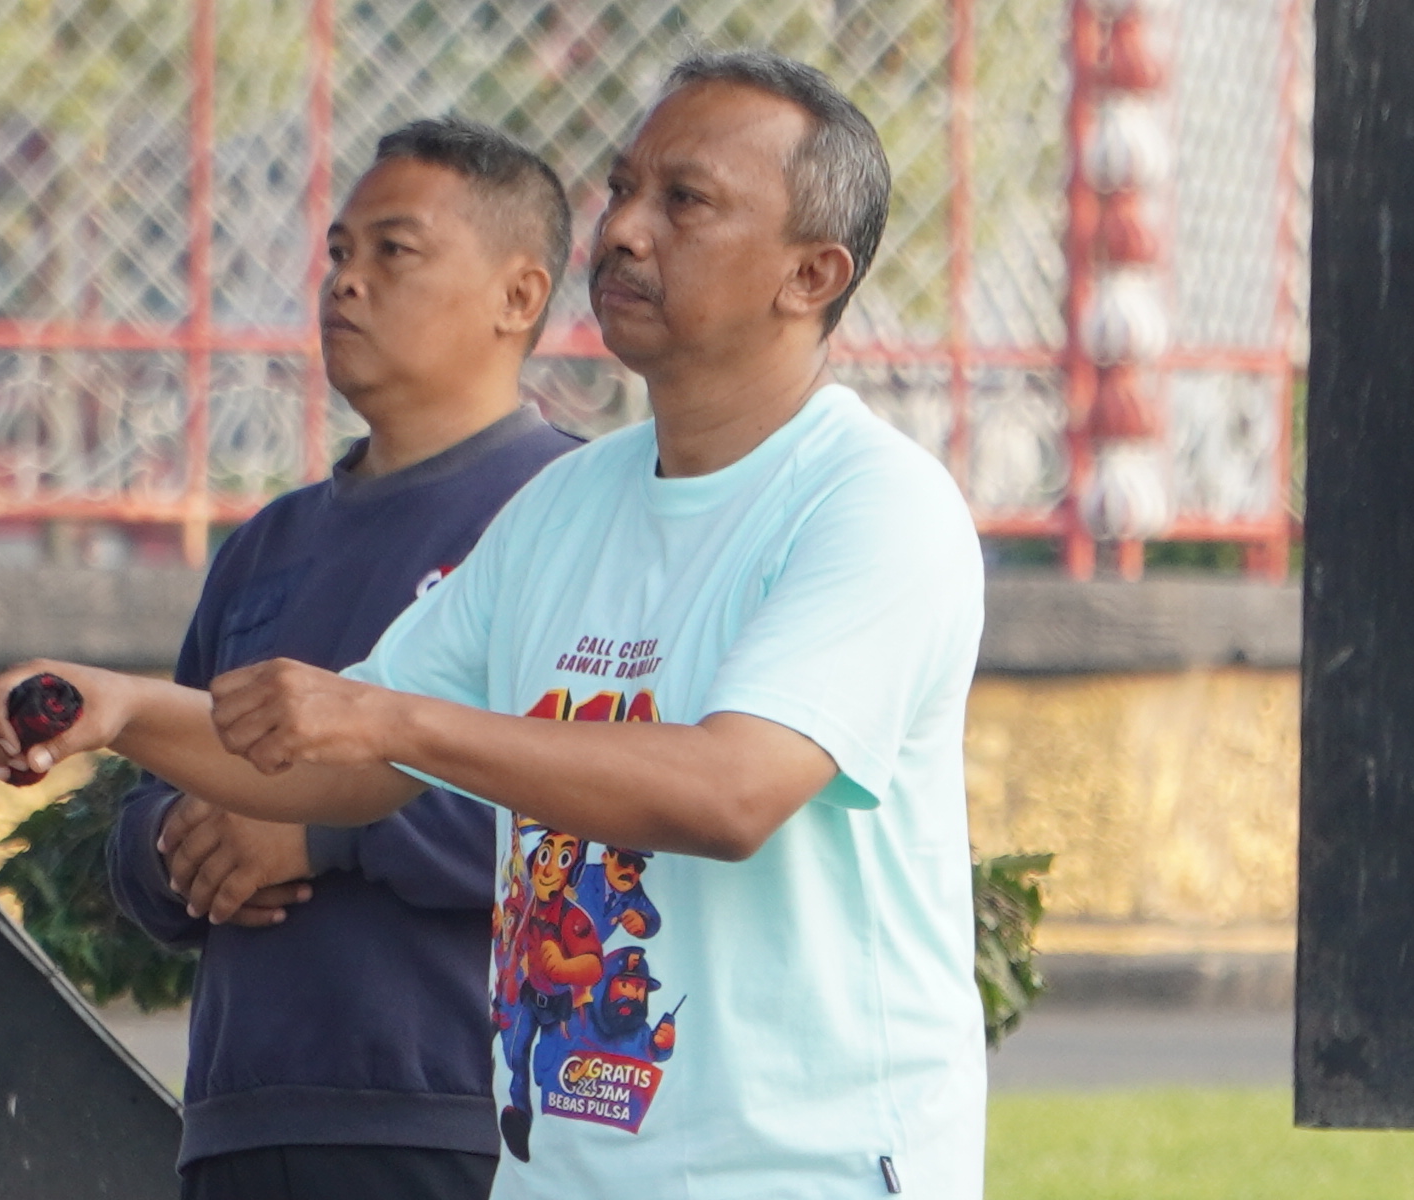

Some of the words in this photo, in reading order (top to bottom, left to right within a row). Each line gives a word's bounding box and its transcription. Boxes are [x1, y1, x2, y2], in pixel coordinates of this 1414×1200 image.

[576, 635, 614, 657] CALL
[556, 653, 613, 677] GAWAT
[585, 1058, 652, 1088] GRATIS
[548, 1091, 586, 1113] BEBAS
[587, 1098, 630, 1121] PULSA
[596, 1084, 631, 1104] JAM
